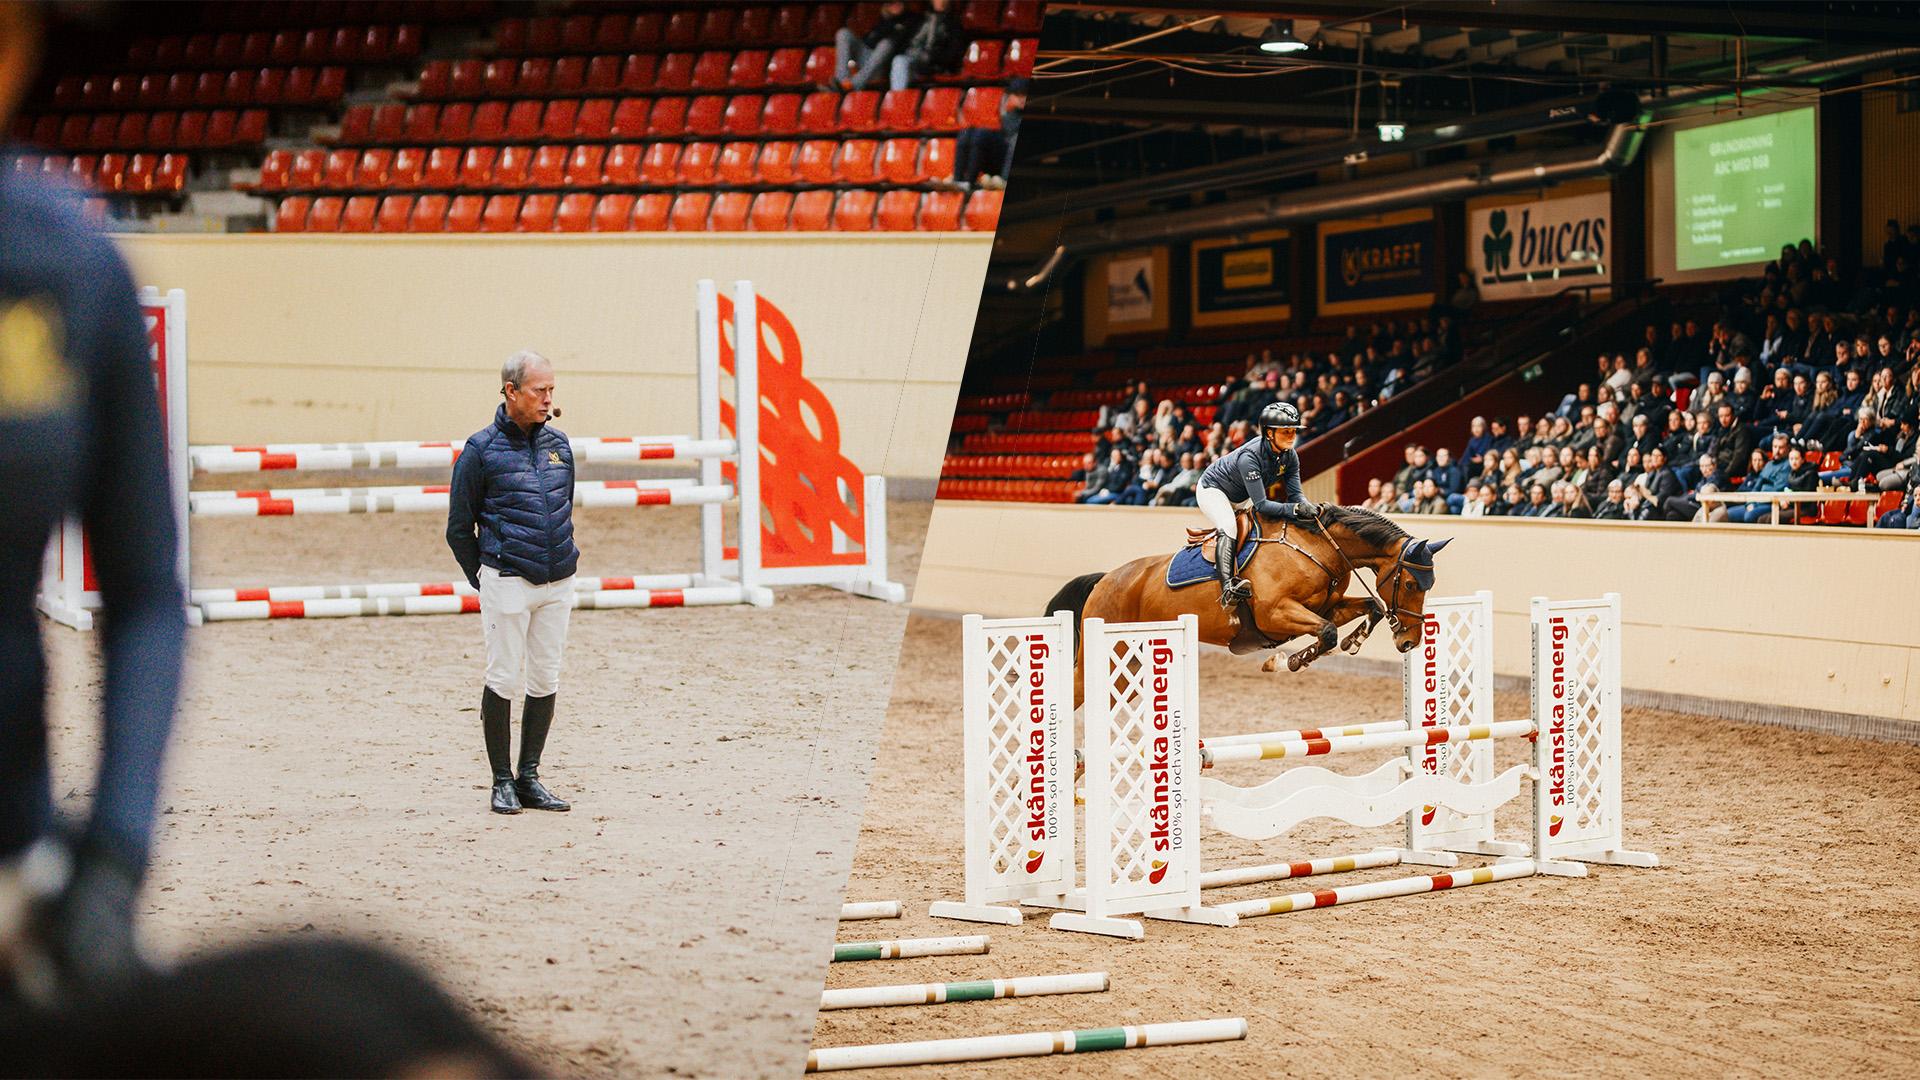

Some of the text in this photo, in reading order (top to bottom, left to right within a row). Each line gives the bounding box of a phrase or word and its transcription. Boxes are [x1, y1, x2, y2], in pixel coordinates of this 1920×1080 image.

[1361, 242, 1421, 269] KRAFFT
[1519, 208, 1605, 267] bucas
[1025, 634, 1049, 841] skånska energi
[1048, 703, 1058, 839] 100% sol och vatten
[1148, 638, 1173, 852] skånska energi
[1172, 709, 1182, 851] 100% sol och vatten
[1549, 617, 1568, 807] skånska energi
[1566, 679, 1575, 805] 100% sol och vatten
